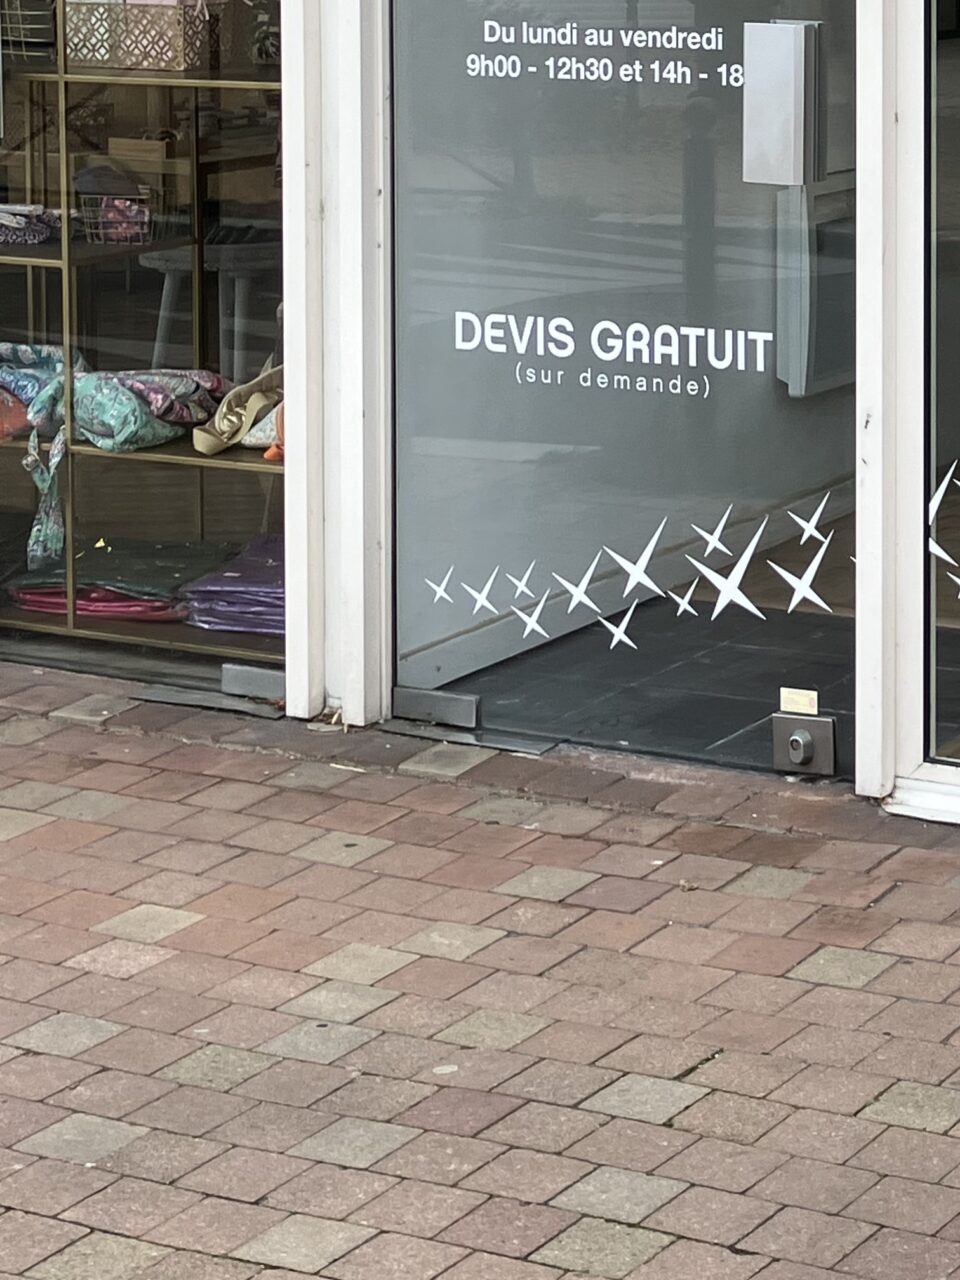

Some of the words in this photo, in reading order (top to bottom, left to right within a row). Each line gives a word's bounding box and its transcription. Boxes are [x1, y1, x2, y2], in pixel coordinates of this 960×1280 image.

[483, 20, 515, 44] Du
[522, 22, 578, 46] lundi
[585, 29, 613, 47] au
[620, 26, 723, 51] vendredi
[466, 54, 521, 78] 9h00
[545, 57, 613, 82] 12h30
[619, 61, 643, 82] et
[650, 60, 691, 85] 14h
[454, 311, 576, 358] DEVIS
[591, 320, 774, 372] GRATUIT
[515, 361, 564, 385] (sur
[579, 368, 711, 399] demande)
